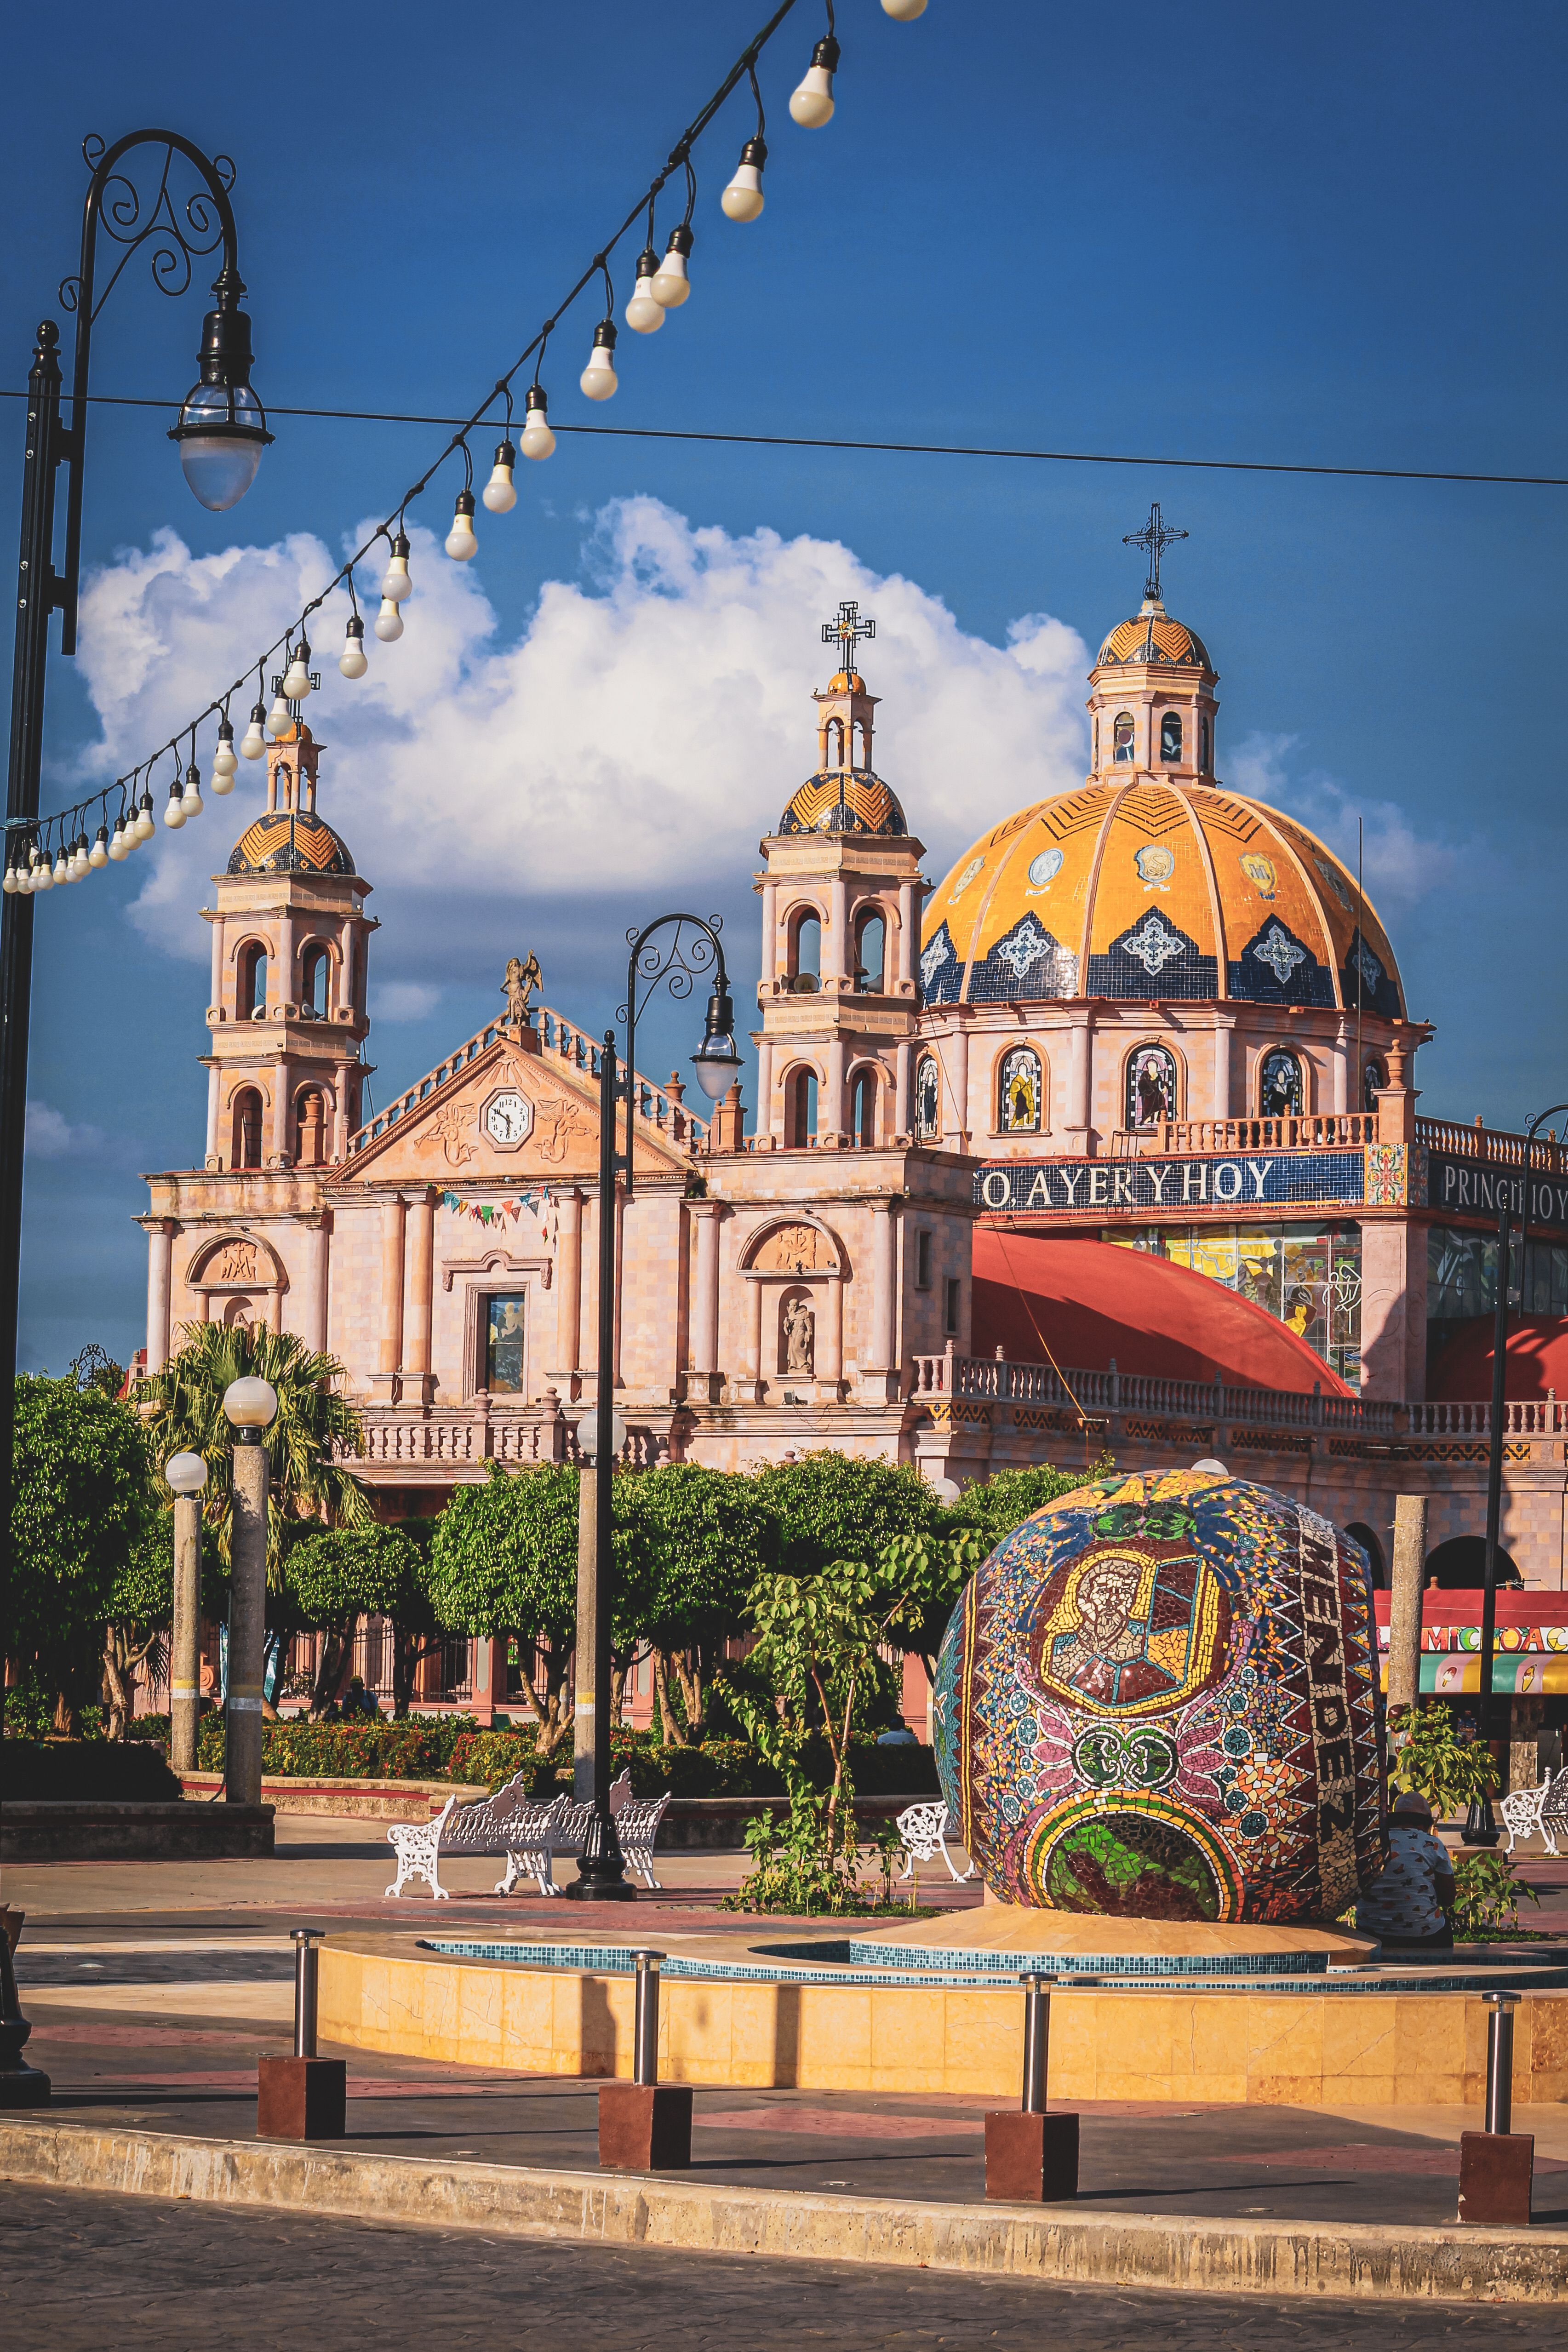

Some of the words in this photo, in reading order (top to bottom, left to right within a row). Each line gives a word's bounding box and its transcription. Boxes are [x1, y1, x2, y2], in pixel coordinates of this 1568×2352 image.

[973, 1171, 1017, 1207] O,
[1025, 1167, 1136, 1207] AYER
[1145, 1165, 1173, 1202] Y
[1182, 1160, 1274, 1201] HOY
